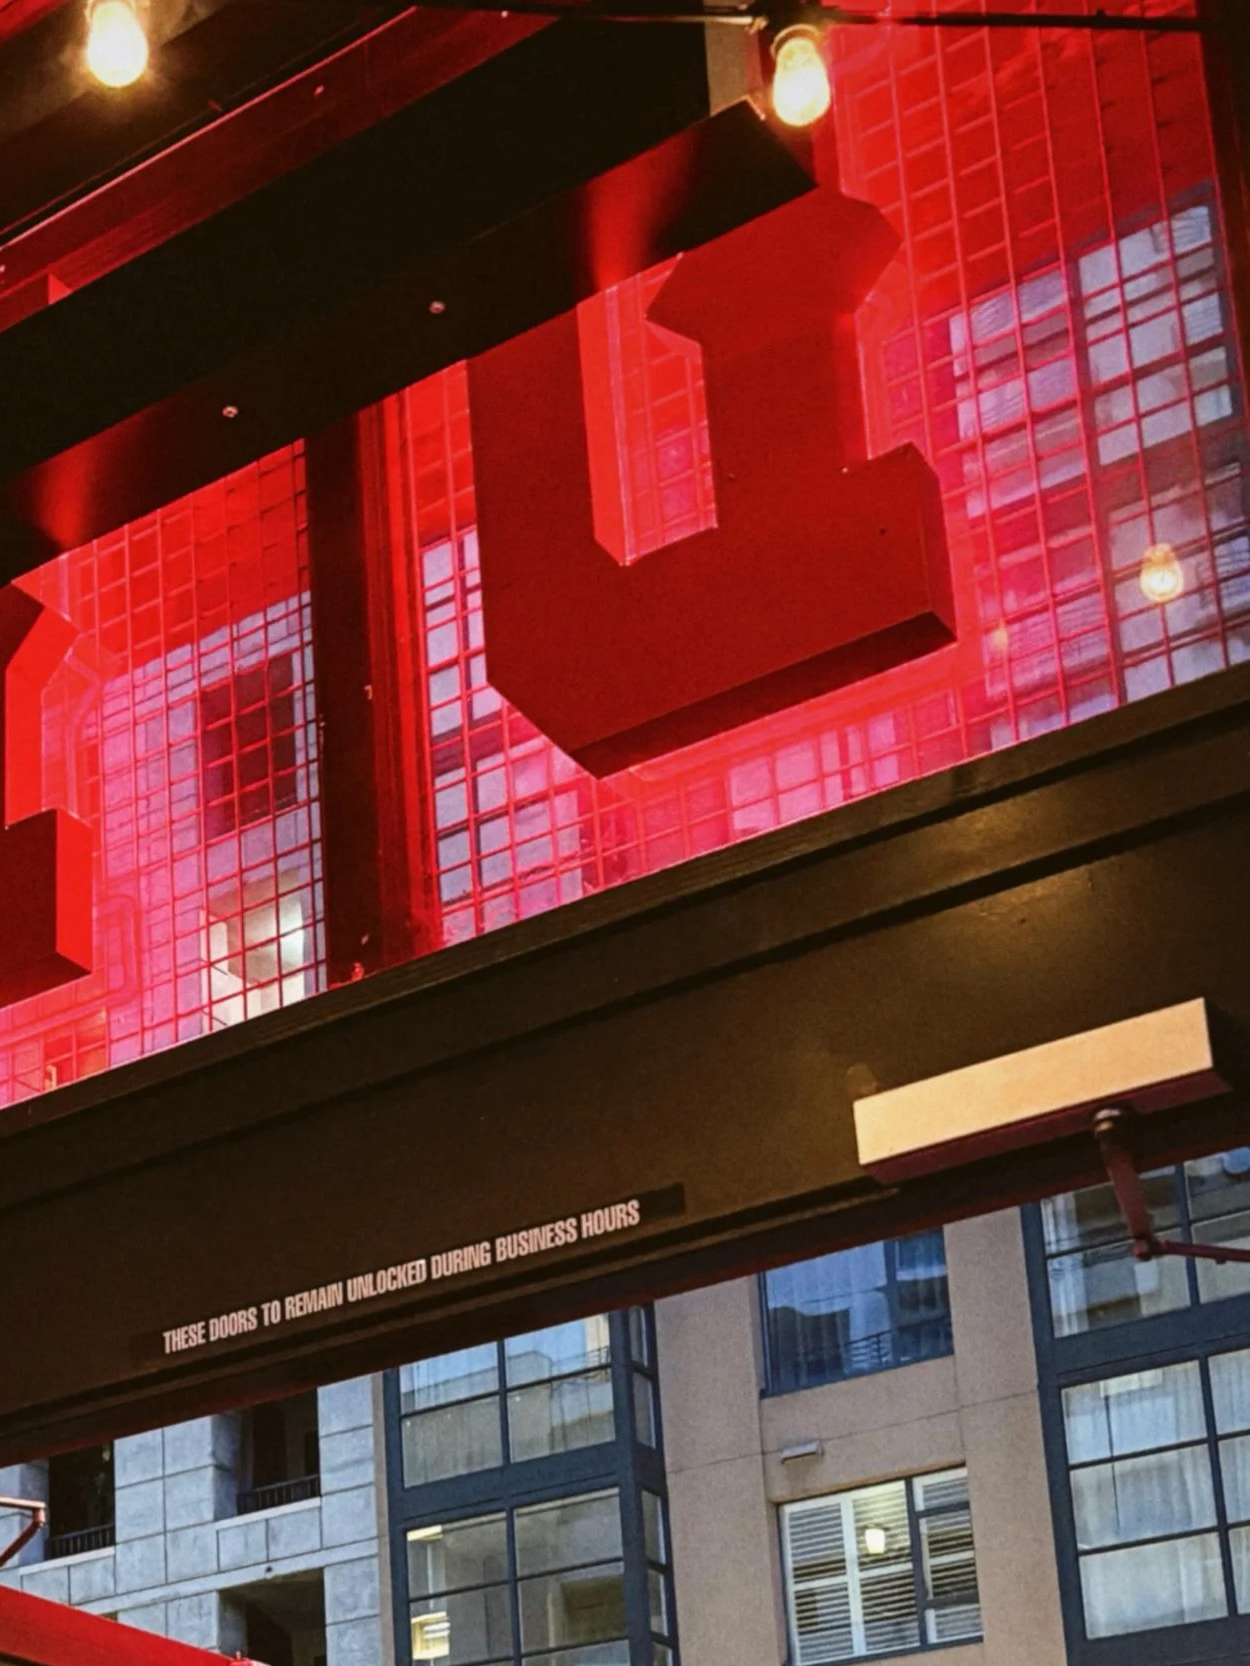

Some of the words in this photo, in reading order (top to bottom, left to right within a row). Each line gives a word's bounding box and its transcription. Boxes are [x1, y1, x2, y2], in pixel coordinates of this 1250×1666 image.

[163, 1324, 206, 1354] THESE
[209, 1307, 258, 1340] DOORS
[261, 1303, 281, 1326] TO
[284, 1282, 343, 1320] REMAIN
[347, 1259, 427, 1302] UNLOCKED
[431, 1241, 491, 1279] DURING
[496, 1217, 578, 1263] BUSINESS
[581, 1199, 640, 1239] HOURS
